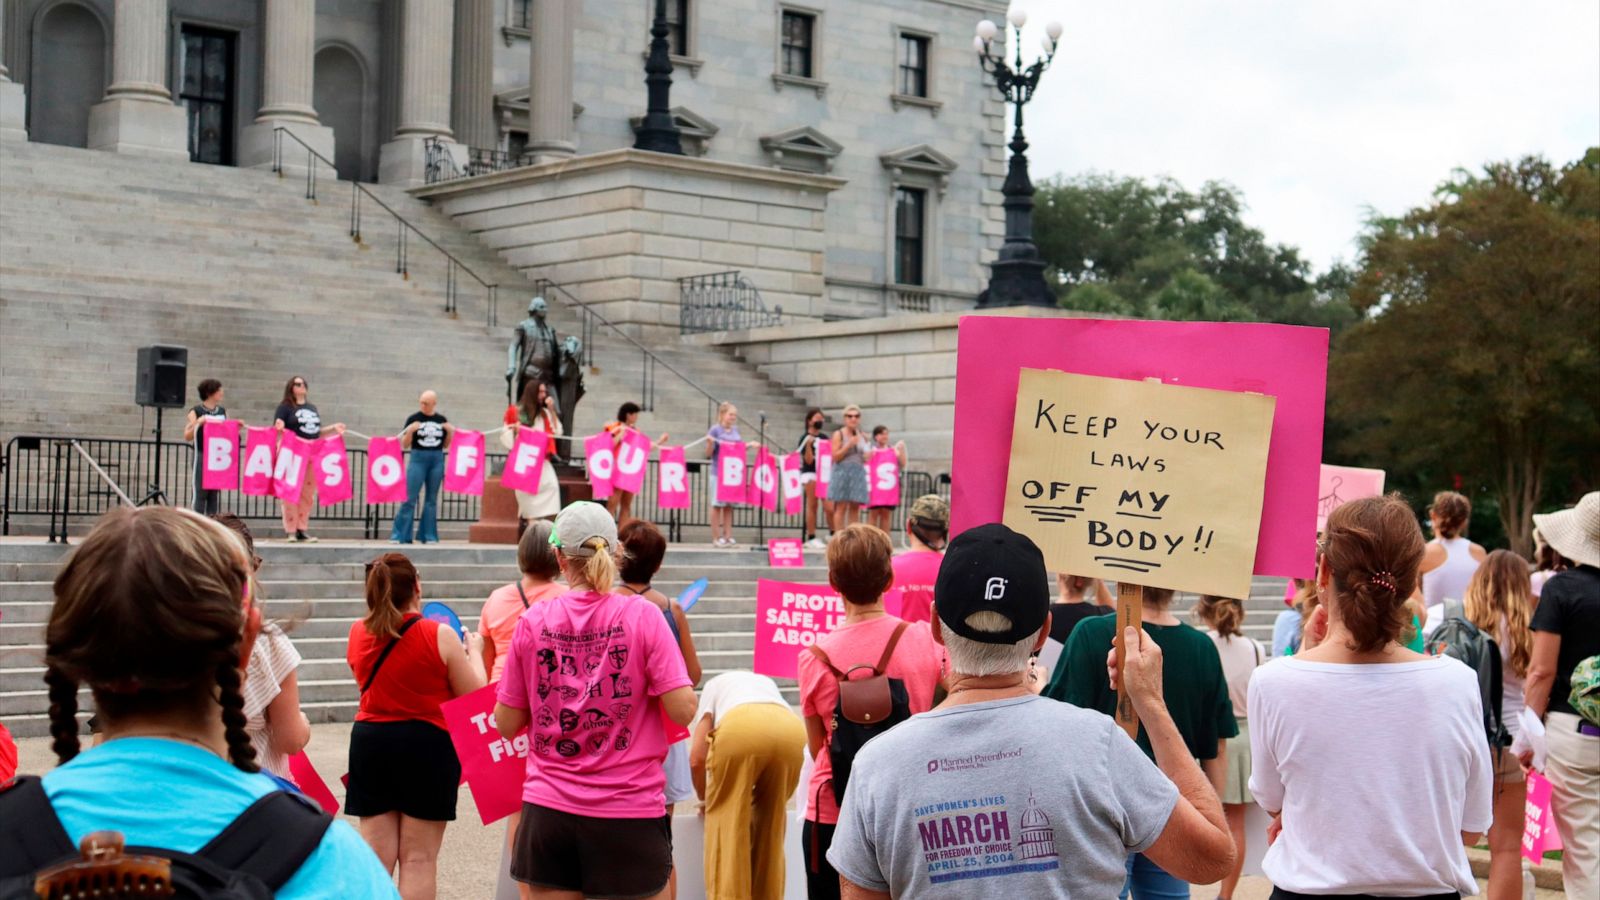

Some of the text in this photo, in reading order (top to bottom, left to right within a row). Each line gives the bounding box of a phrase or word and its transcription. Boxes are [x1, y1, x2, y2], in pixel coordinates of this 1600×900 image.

[1034, 398, 1225, 450] KEEP YOUR
[207, 436, 344, 487] BANS
[370, 442, 541, 487] OFF
[589, 443, 686, 493] OUR
[1090, 450, 1167, 473] LAWS
[1021, 479, 1171, 513] OFF MY
[765, 607, 820, 632] SAFE,
[940, 747, 1022, 768] Planned Parenthood
[914, 795, 1006, 817] SAVE WOMEN'S LIVES
[917, 810, 1011, 851] MARCH
[925, 842, 1013, 863] FOR FREEDOM OF CHOICE
[927, 852, 1015, 873] APRIL 25, 2004
